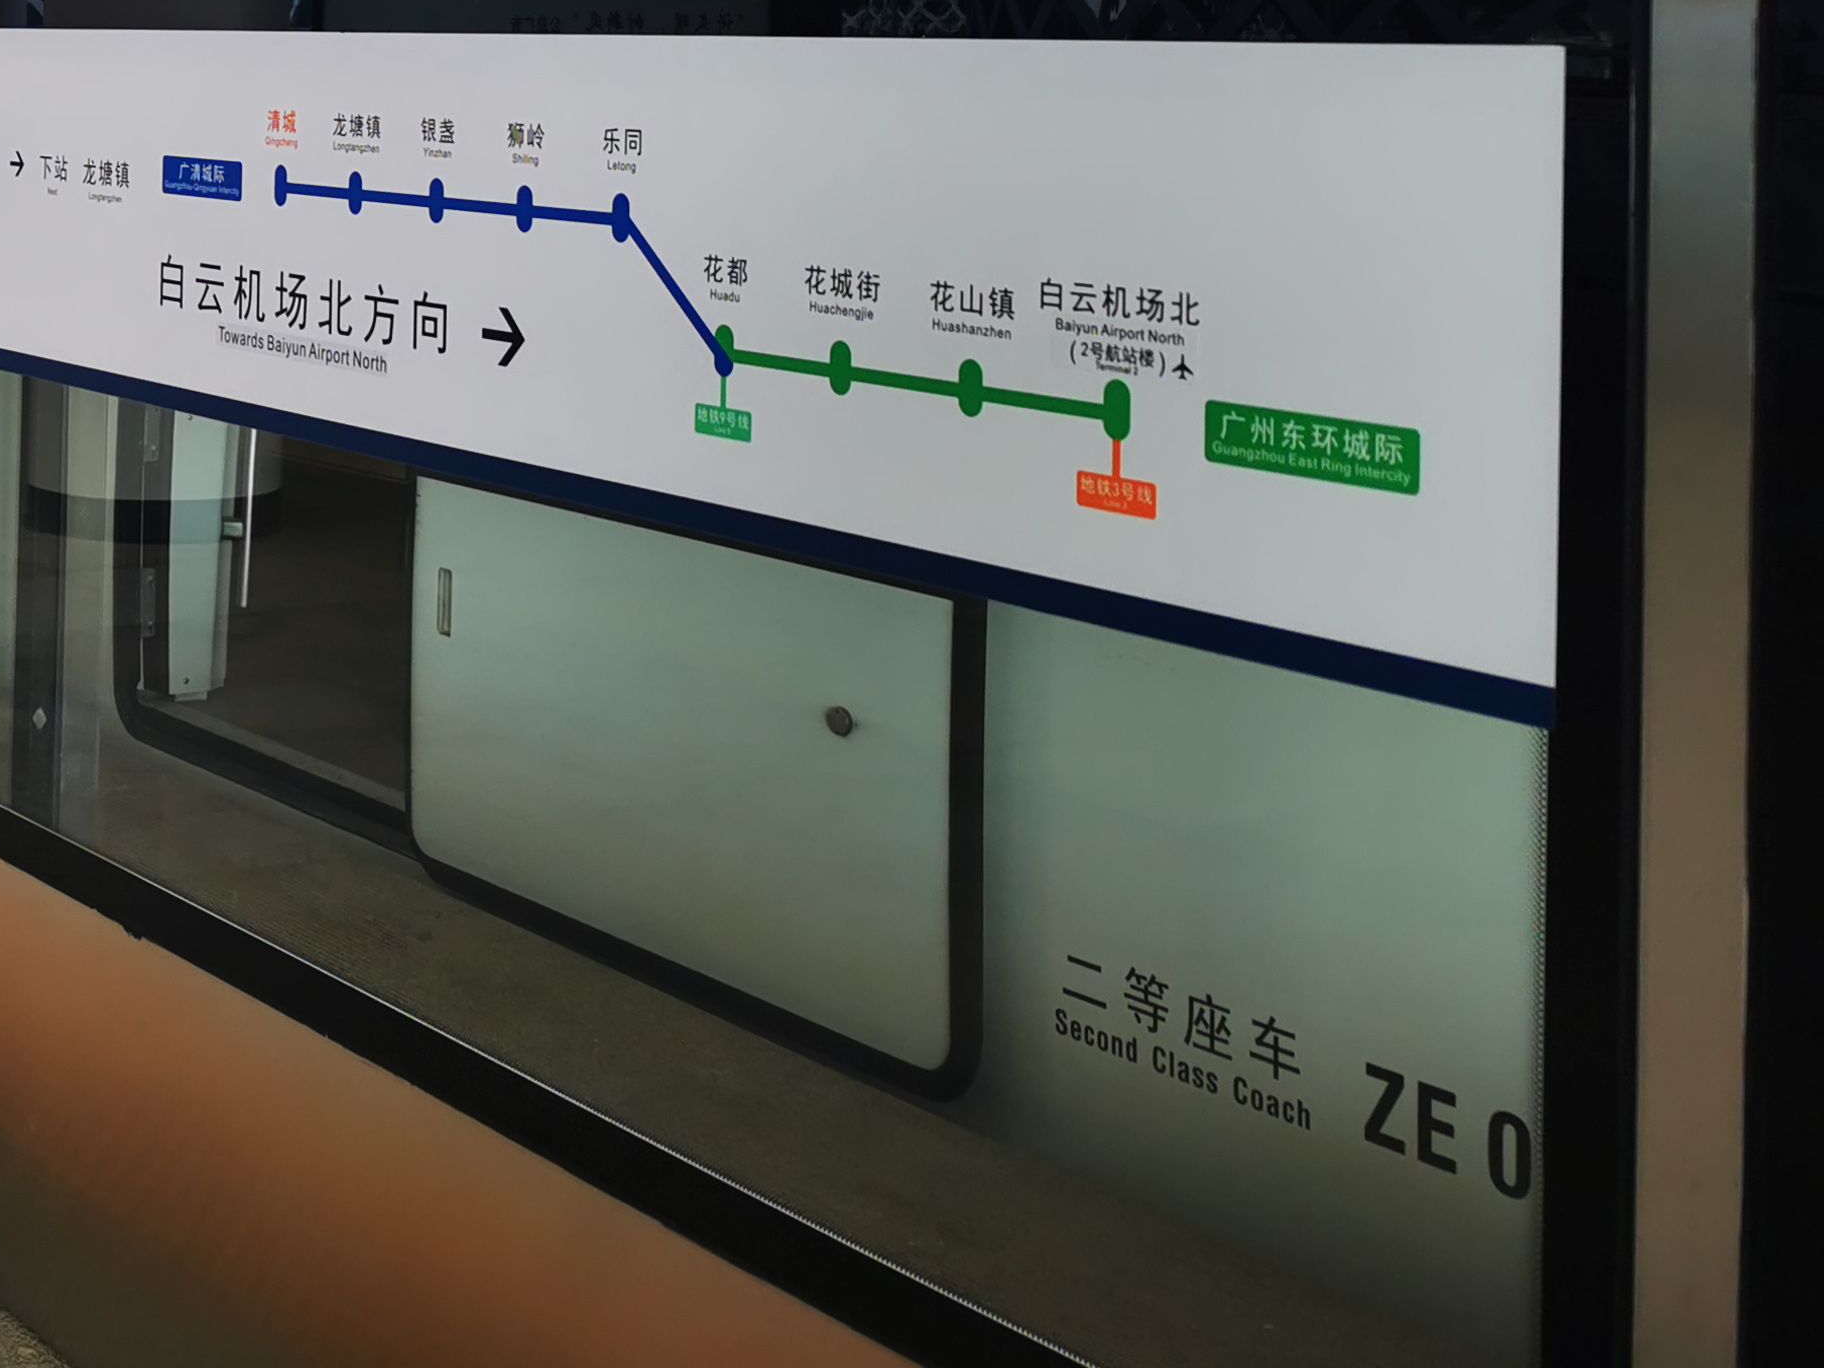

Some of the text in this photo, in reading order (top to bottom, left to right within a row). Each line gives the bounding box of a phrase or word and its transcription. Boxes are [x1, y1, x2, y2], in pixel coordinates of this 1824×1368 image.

[267, 110, 297, 134] 清城
[333, 112, 381, 139] 龙塘镇
[421, 117, 455, 144] 银盏
[507, 122, 545, 149] 狮岭
[265, 135, 298, 150] Qingcheng
[333, 141, 379, 154] Longtangzhen
[423, 147, 452, 159] Yinzhan
[603, 128, 642, 156] 乐同
[40, 155, 68, 183] 下站
[83, 158, 130, 189] 龙塘镇
[179, 161, 224, 184] 广清城际
[512, 153, 539, 167] Shiling
[607, 160, 637, 174] Letong
[704, 254, 748, 287] 花都
[804, 264, 881, 303] 花城街
[159, 254, 449, 354] 白云机场北方向
[709, 288, 741, 303] Huadu
[930, 280, 1015, 320] 花山镇
[1039, 277, 1200, 326] 白云机场北
[809, 301, 874, 322] Huachengjie
[932, 319, 1012, 340] Huashanzhen
[1055, 318, 1185, 346] Baiyun Airport North
[218, 326, 388, 374] Towards Baiyun Airport North
[697, 405, 750, 430] 地铁9号线
[1220, 411, 1403, 465] 广州东环城际
[1212, 440, 1411, 486] Guangzhou East Ring Intercity
[1081, 474, 1152, 505] 地铁3号线
[1062, 954, 1301, 1080] 二等座车
[1055, 1008, 1311, 1131] Second Class Coach
[1364, 1061, 1457, 1175] ZE
